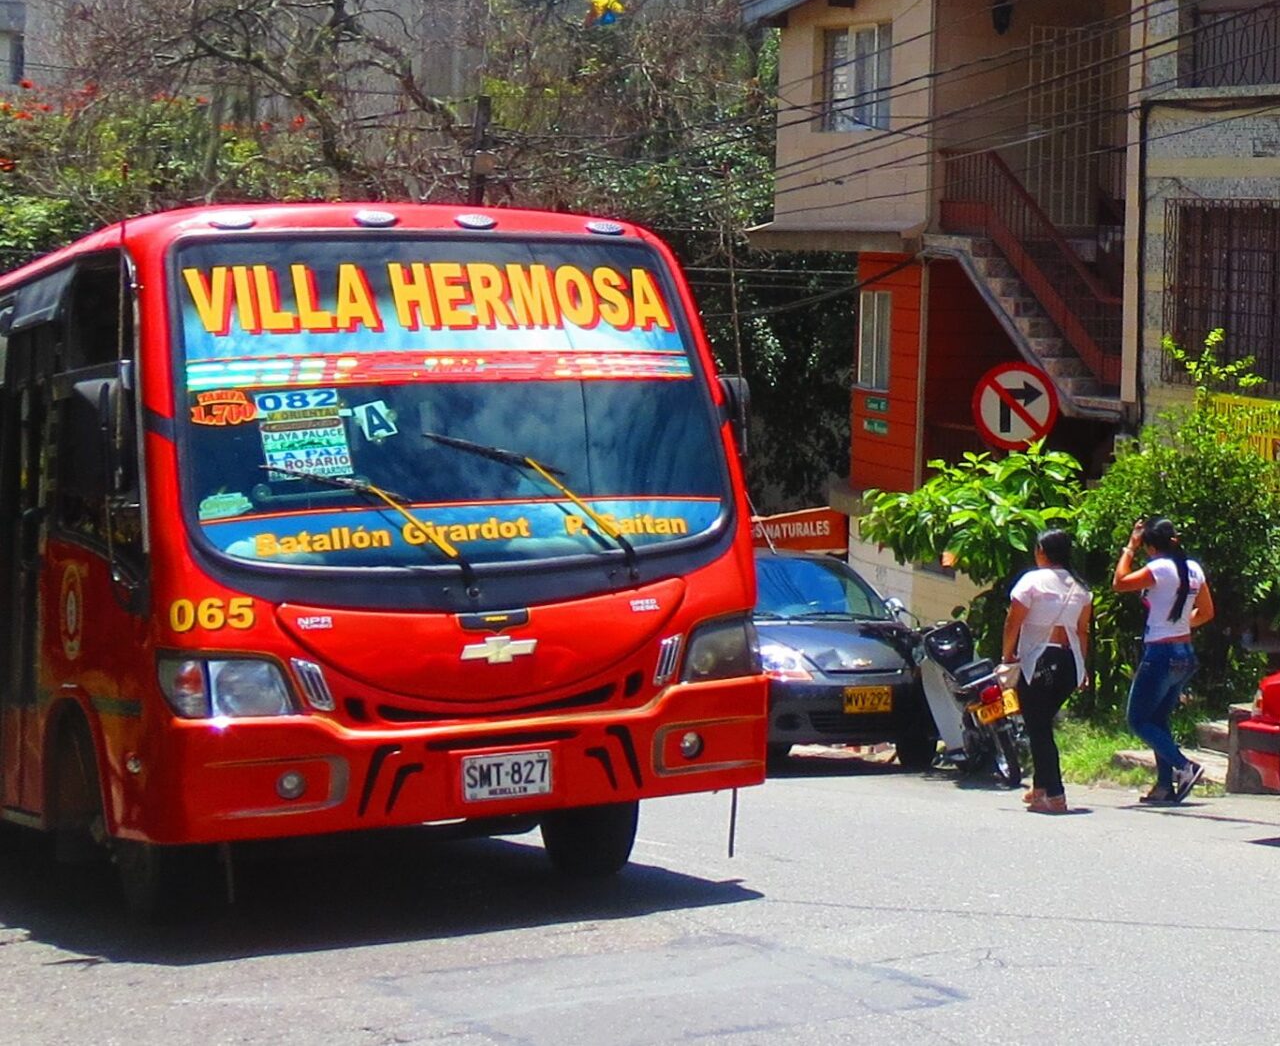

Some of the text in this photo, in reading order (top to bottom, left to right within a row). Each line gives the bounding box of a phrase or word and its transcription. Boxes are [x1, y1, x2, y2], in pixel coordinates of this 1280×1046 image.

[182, 262, 677, 336] VILLA HERMOSA
[258, 390, 337, 412] 082
[363, 404, 395, 438] A
[264, 428, 345, 443] PLAYA PALACE
[268, 451, 297, 462] LA
[285, 455, 349, 471] ROSARIO
[255, 525, 392, 558] Batallón
[402, 515, 532, 546] Girardot
[766, 520, 831, 539] NATURALES
[168, 596, 256, 633] 065
[297, 615, 333, 626] NPR
[488, 786, 528, 796] MEDELLIN
